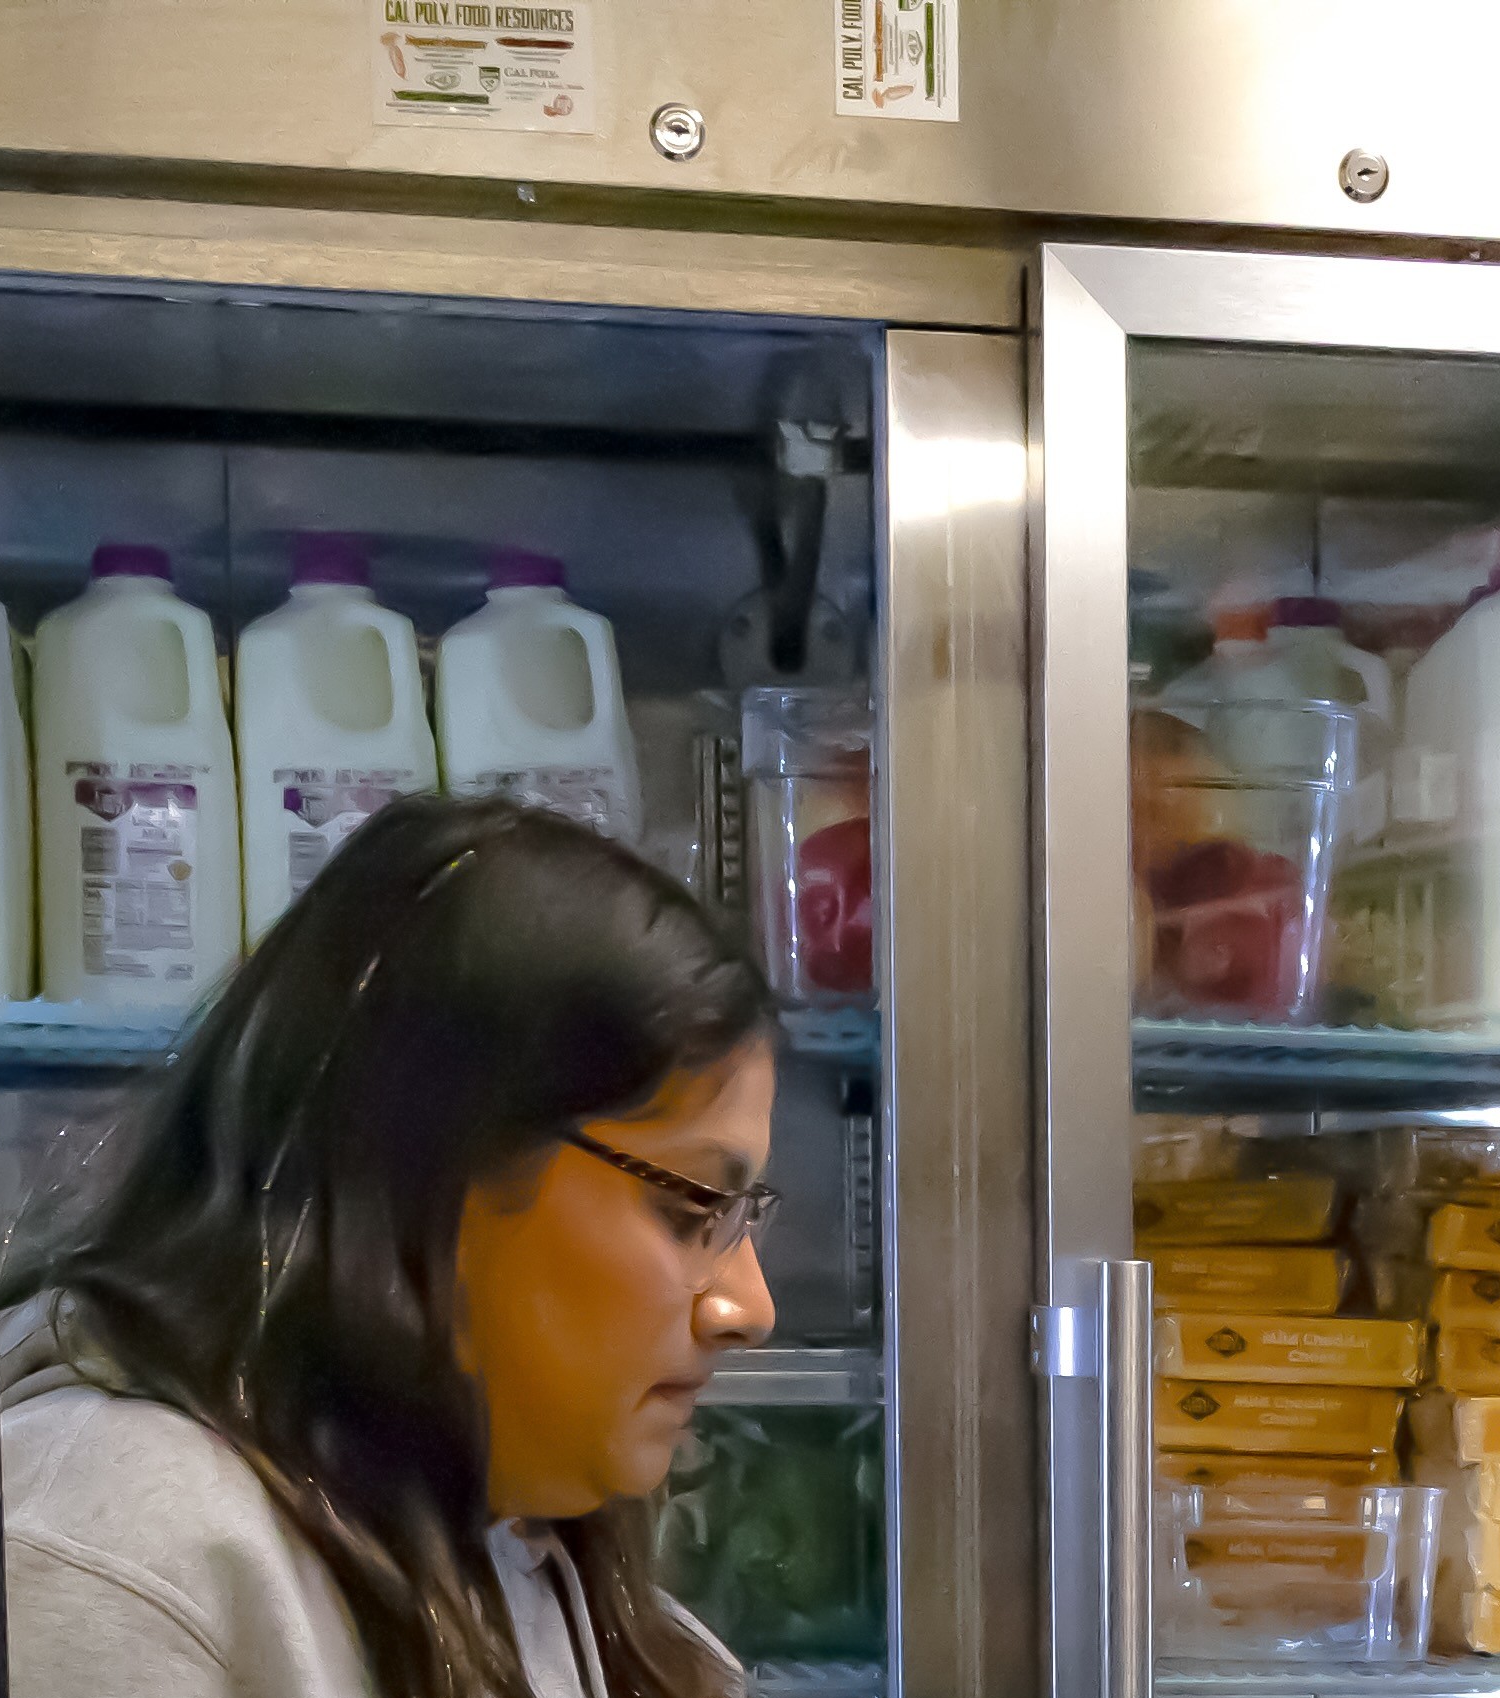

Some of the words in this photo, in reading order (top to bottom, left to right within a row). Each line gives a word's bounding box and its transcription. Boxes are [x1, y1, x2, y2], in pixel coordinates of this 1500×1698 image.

[384, 0, 409, 22] CAL
[415, 2, 450, 25] POLY
[456, 5, 491, 27] FOOD
[496, 6, 574, 32] RESOURCES
[842, 75, 864, 100] CAL
